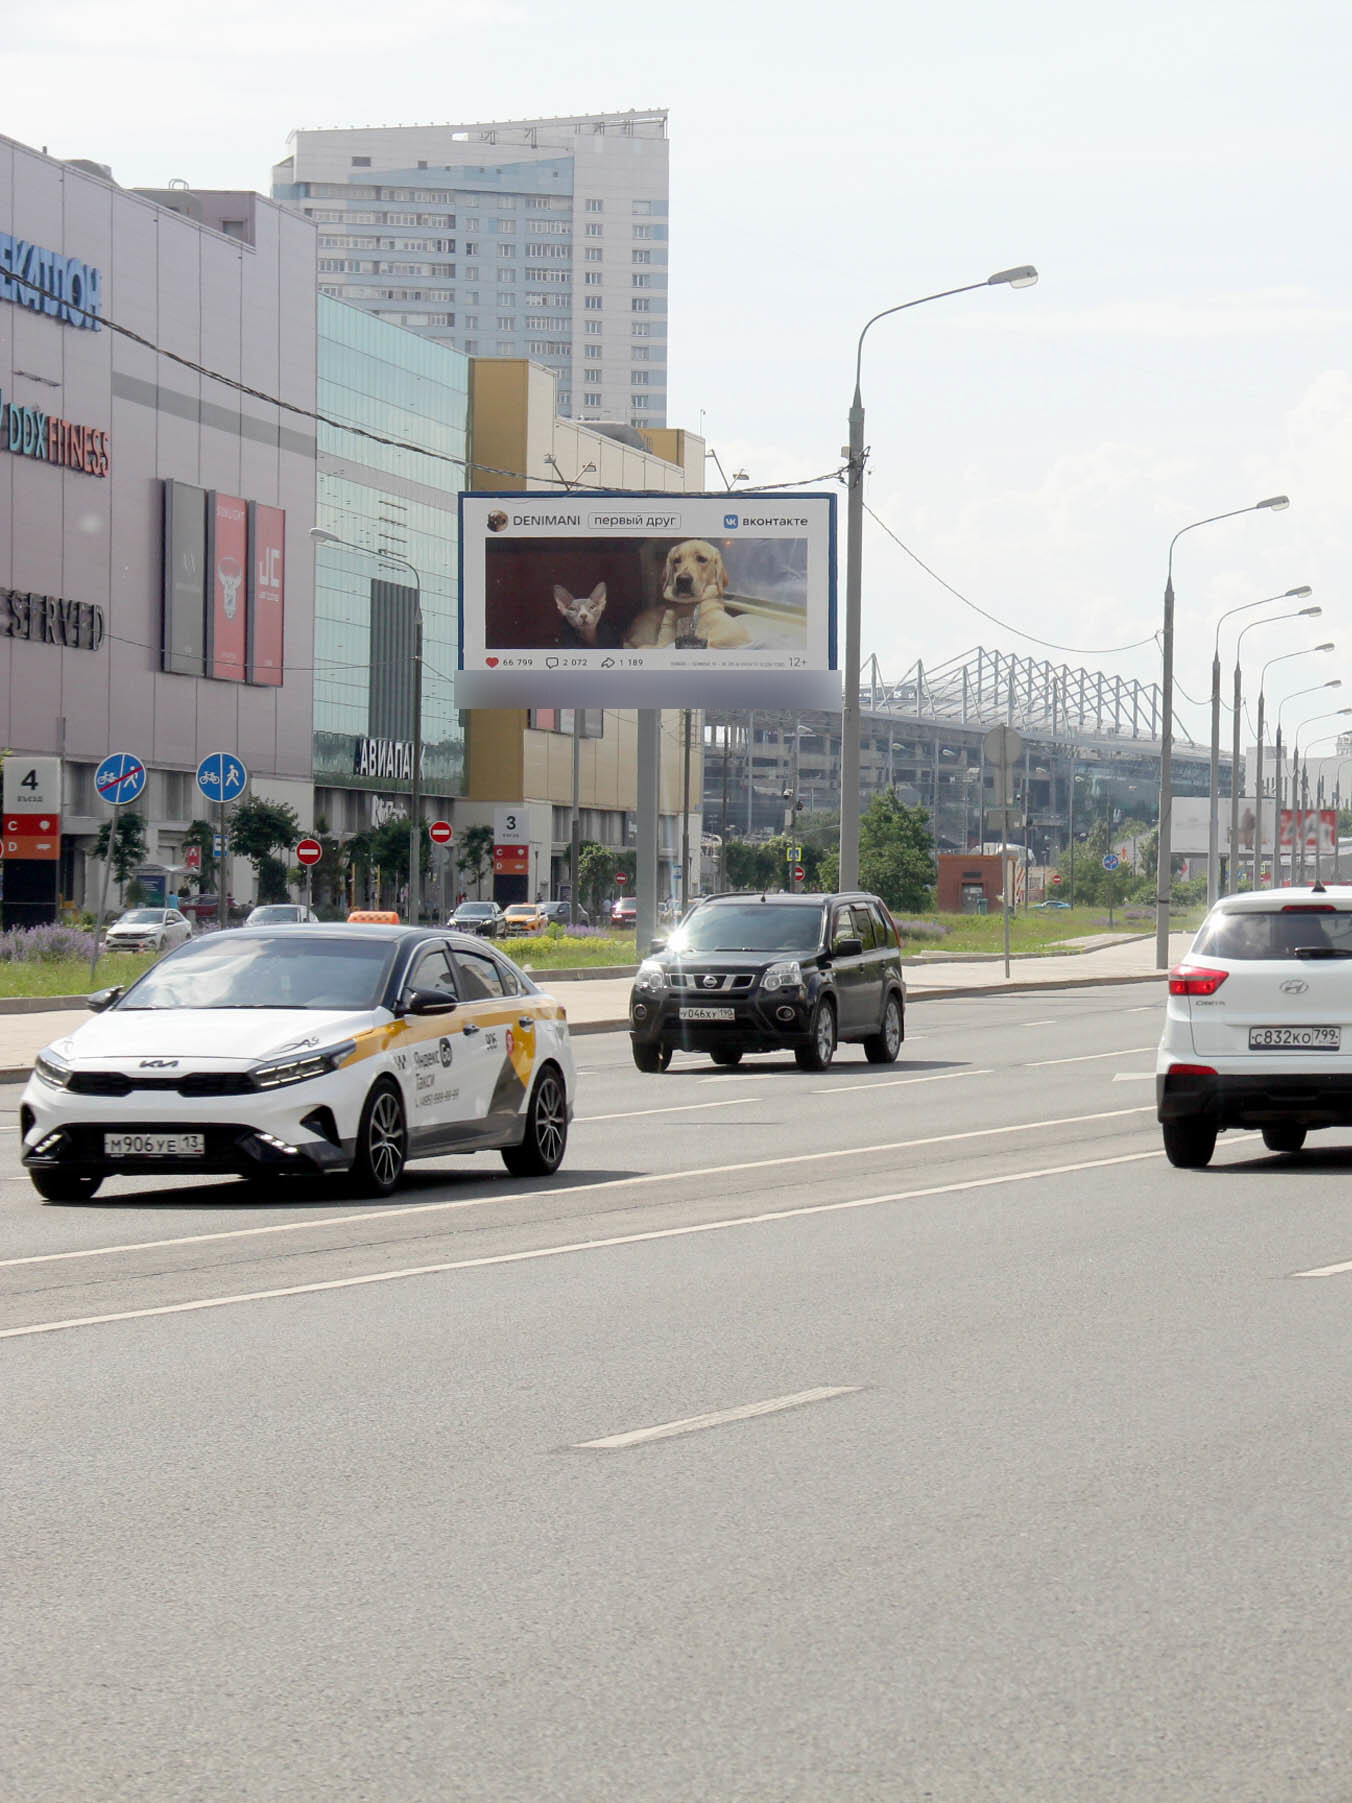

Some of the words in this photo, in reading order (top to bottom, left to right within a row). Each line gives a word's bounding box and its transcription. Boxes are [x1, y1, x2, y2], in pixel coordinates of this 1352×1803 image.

[9, 402, 46, 460] DDX
[49, 415, 110, 478] FITNESS
[513, 515, 580, 526] DENIMANI
[594, 514, 643, 527] первый
[646, 516, 676, 527] друг
[742, 517, 808, 526] вконтакте
[503, 659, 514, 667] 66
[516, 659, 533, 667] 799
[562, 659, 568, 667] 2
[571, 659, 588, 667] 072
[628, 659, 643, 667] 189
[789, 656, 808, 667] 12+
[360, 738, 426, 781] АВИАПАК
[21, 769, 38, 790] 4
[506, 815, 516, 830] 3
[1254, 1030, 1312, 1045] С832КО
[1313, 1029, 1337, 1041] 799
[111, 1135, 177, 1152] М906УЕ
[182, 1135, 198, 1148] 13
